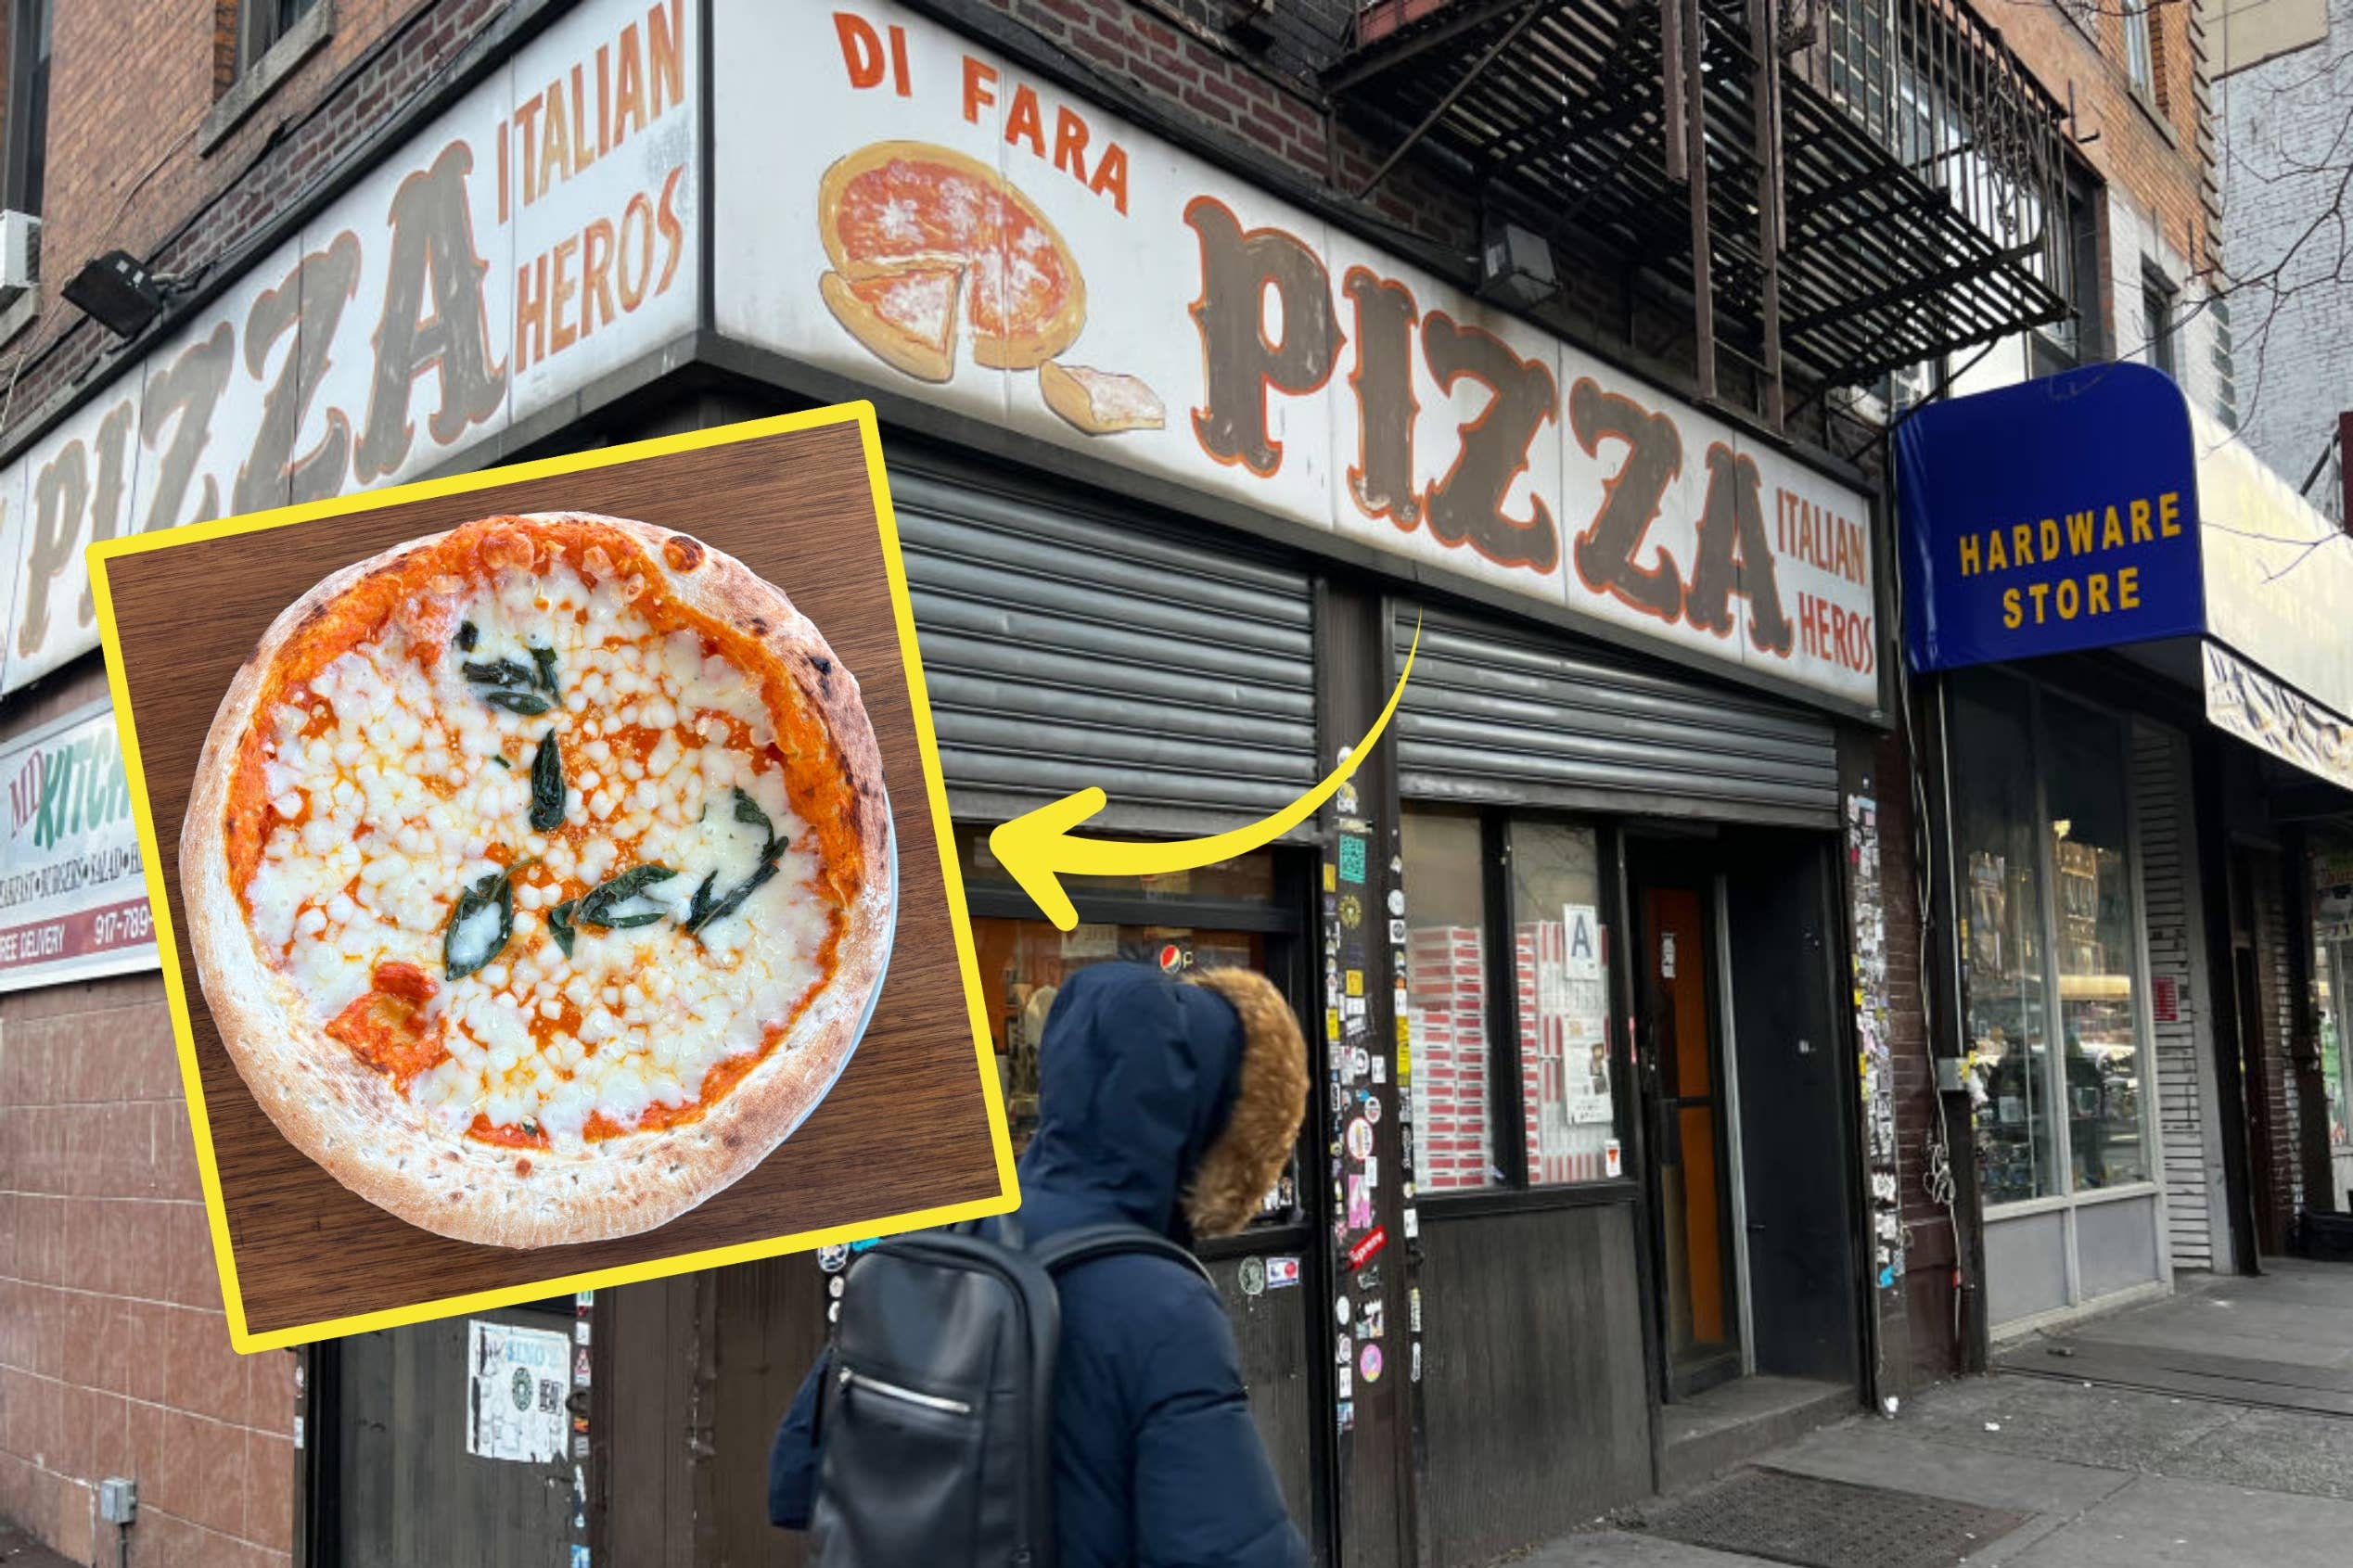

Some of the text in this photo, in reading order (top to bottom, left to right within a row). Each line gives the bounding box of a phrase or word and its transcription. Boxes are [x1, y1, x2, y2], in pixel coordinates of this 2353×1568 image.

[497, 1, 684, 224] ITALIAN
[834, 12, 1129, 216] DI FARA
[515, 164, 686, 374] HEROS
[19, 139, 509, 657] PIZZA
[1183, 195, 1794, 658] PIZZA
[1777, 487, 1864, 586] ITALIAN
[1959, 491, 2181, 576] HARDWARE
[2002, 567, 2141, 629] STORE
[1798, 592, 1873, 674] HEROS
[1571, 913, 1592, 957] A
